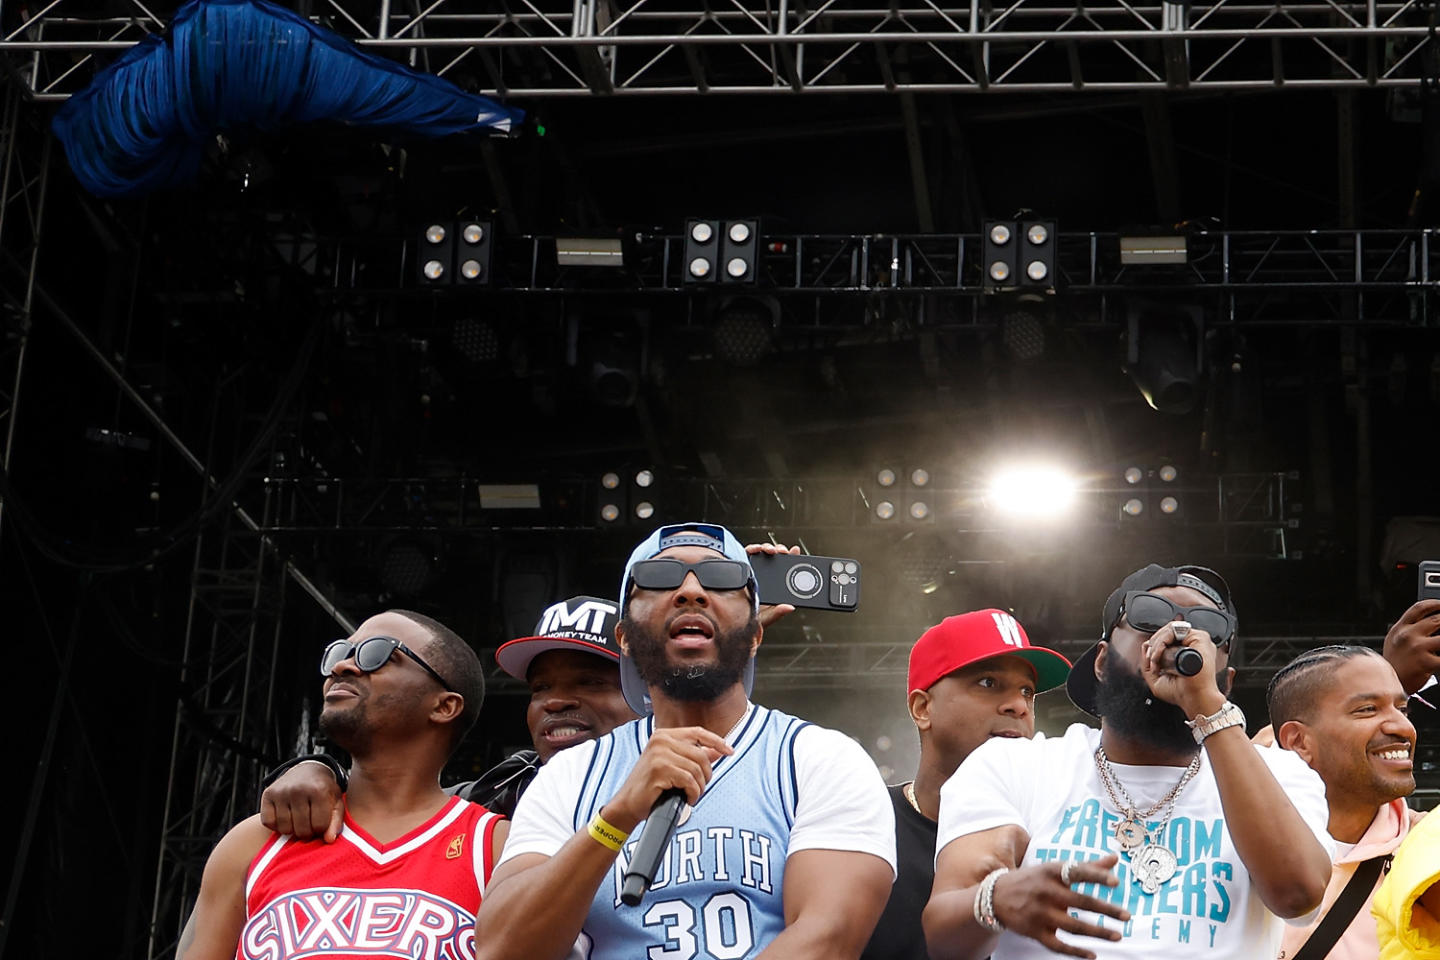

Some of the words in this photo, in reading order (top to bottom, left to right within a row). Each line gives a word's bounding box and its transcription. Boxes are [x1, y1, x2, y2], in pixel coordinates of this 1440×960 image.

[578, 632, 608, 645] TEAM
[1051, 799, 1224, 867] FREOM
[1071, 911, 1217, 948] ADEMY
